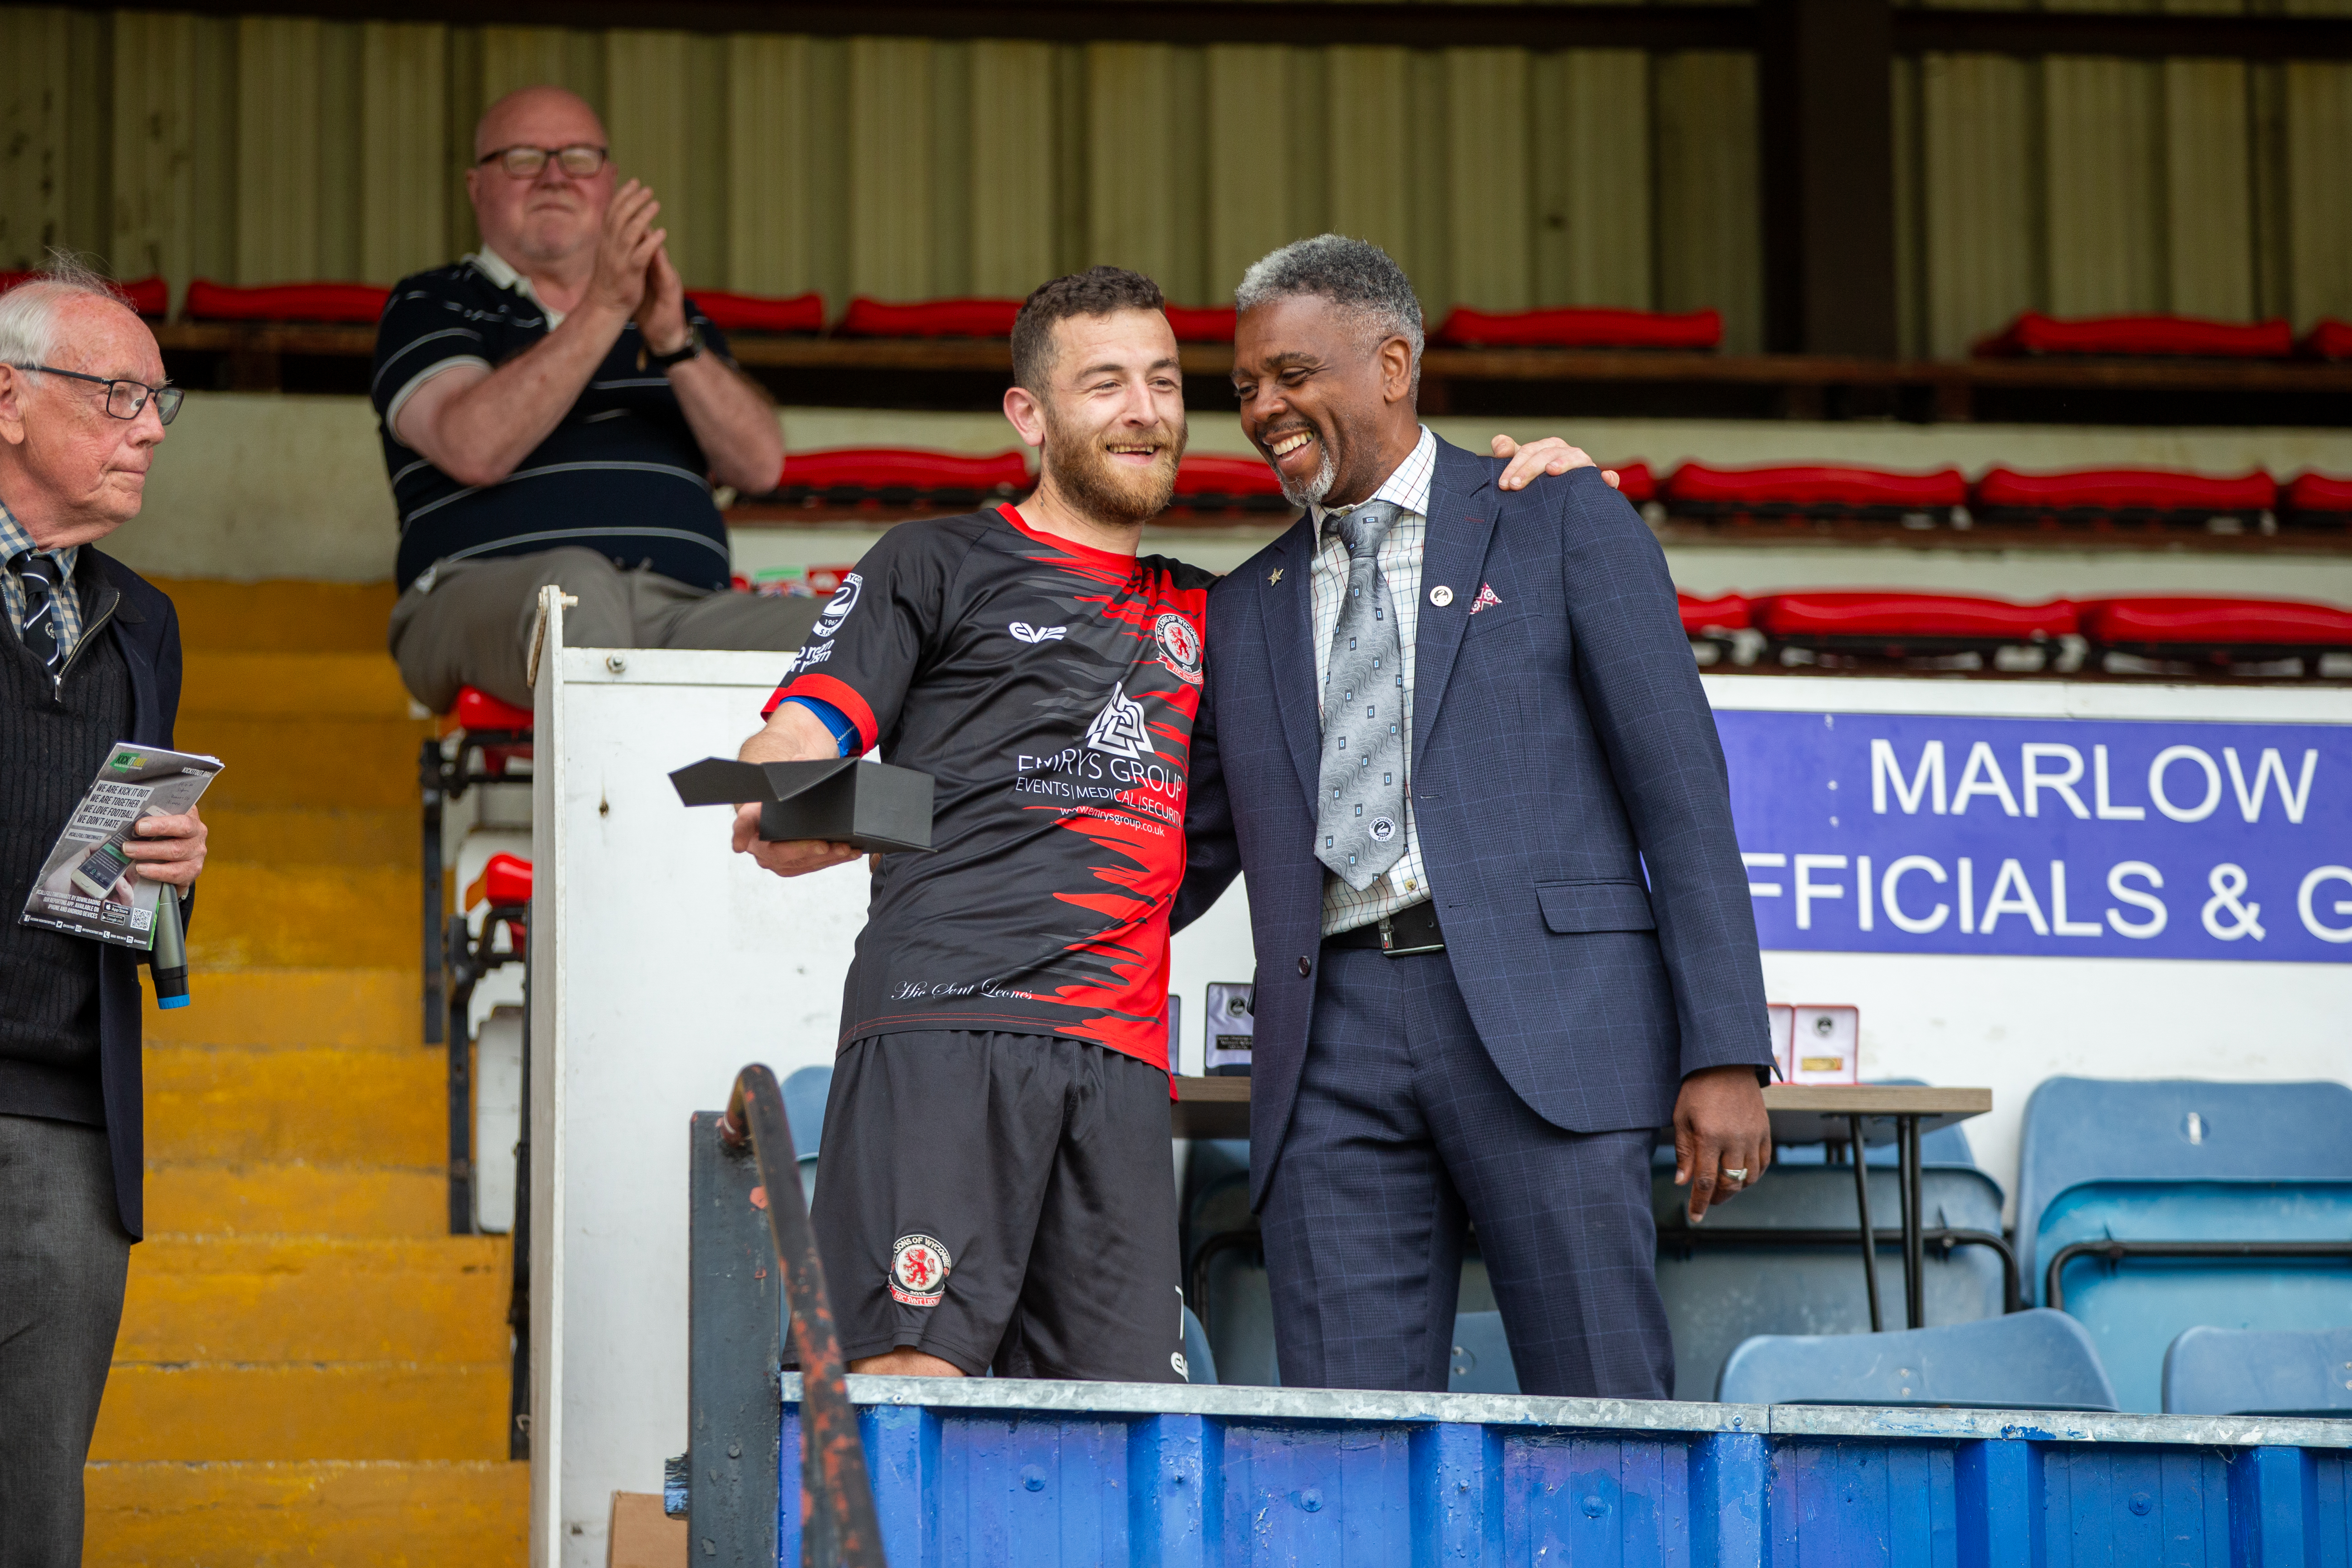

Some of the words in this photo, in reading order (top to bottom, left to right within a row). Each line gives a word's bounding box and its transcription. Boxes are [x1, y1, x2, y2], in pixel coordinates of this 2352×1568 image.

[1159, 616, 1170, 628] LIONS
[1157, 627, 1164, 636] FC
[1177, 617, 1199, 646] WYCOMBE
[115, 755, 131, 765] KICK
[127, 757, 137, 766] IT
[133, 757, 148, 767] OUT
[181, 767, 213, 778] KICKITOUT.ORG
[1019, 748, 1102, 779] EMRYS
[1110, 758, 1182, 801] GROUP
[1870, 738, 2318, 824] MARLOW
[96, 783, 106, 793] WE
[106, 785, 119, 794] ARE
[118, 786, 133, 796] KICK
[132, 788, 139, 797] IT
[137, 789, 151, 799] OUT
[89, 794, 99, 803] WE
[100, 795, 113, 805] ARE
[111, 797, 140, 808] TOGETHER
[83, 804, 93, 813] WE
[93, 806, 109, 815] LOVE
[107, 808, 135, 819] FOOTBALL
[77, 814, 88, 823] WE
[87, 816, 104, 826] DON'T
[103, 818, 120, 828] HATE
[1060, 805, 1165, 837] www.emrysgroup.co.uk
[69, 831, 103, 841] #CALLFULLTIMEONHATE
[36, 889, 71, 900] #CALLFULLTIMEONHATE
[76, 896, 101, 906] DOWNLOADING
[1740, 852, 2168, 939] FFICIALS
[2201, 863, 2267, 943] &
[74, 902, 93, 911] AVAILABLE
[82, 911, 98, 919] DEVICES
[891, 980, 928, 1000] Hic
[977, 978, 1033, 1000] Leones
[894, 1238, 912, 1254] LIONS
[925, 1238, 950, 1269] WYCOMBE
[894, 1291, 906, 1301] HIC
